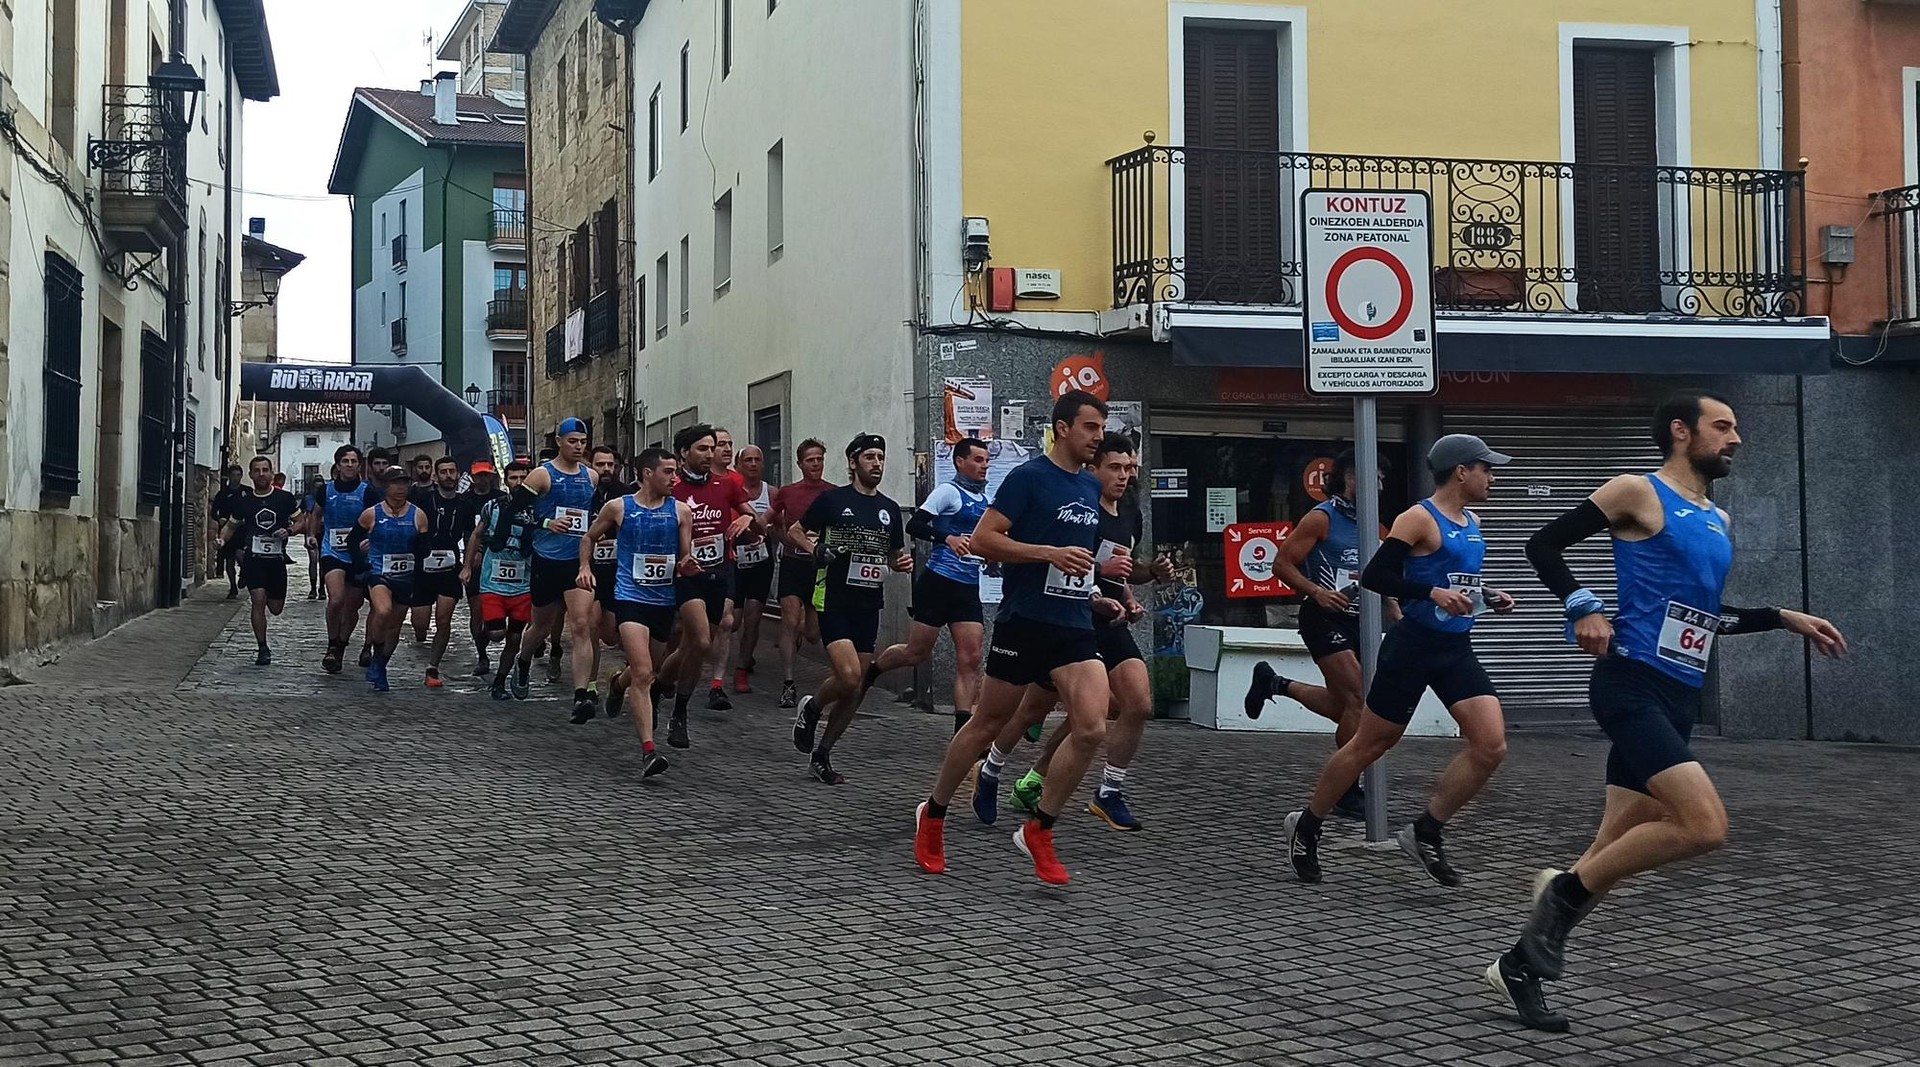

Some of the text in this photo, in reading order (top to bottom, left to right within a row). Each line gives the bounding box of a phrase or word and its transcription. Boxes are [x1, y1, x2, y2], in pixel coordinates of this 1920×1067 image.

[1327, 197, 1406, 213] KONTUZ
[1310, 217, 1424, 228] OINEZKOEN ALDERDIA
[1324, 233, 1410, 242] ZONA PEATONAL
[1470, 227, 1505, 246] 1883
[1312, 347, 1431, 355] ZAMALANAK ETA BAIMENDUTAKO
[1317, 371, 1427, 379] EXCEPTO CARGA Y DESCARGA
[1329, 379, 1370, 387] VEHÍCULOS
[263, 543, 272, 553] 5
[597, 547, 614, 558] 37
[696, 545, 718, 560] 43
[436, 557, 445, 567] 7
[745, 552, 761, 562] 11
[390, 561, 408, 572] 46
[644, 564, 666, 578] 36
[860, 565, 881, 579] 66
[500, 567, 516, 578] 30
[1680, 627, 1708, 654] 64
